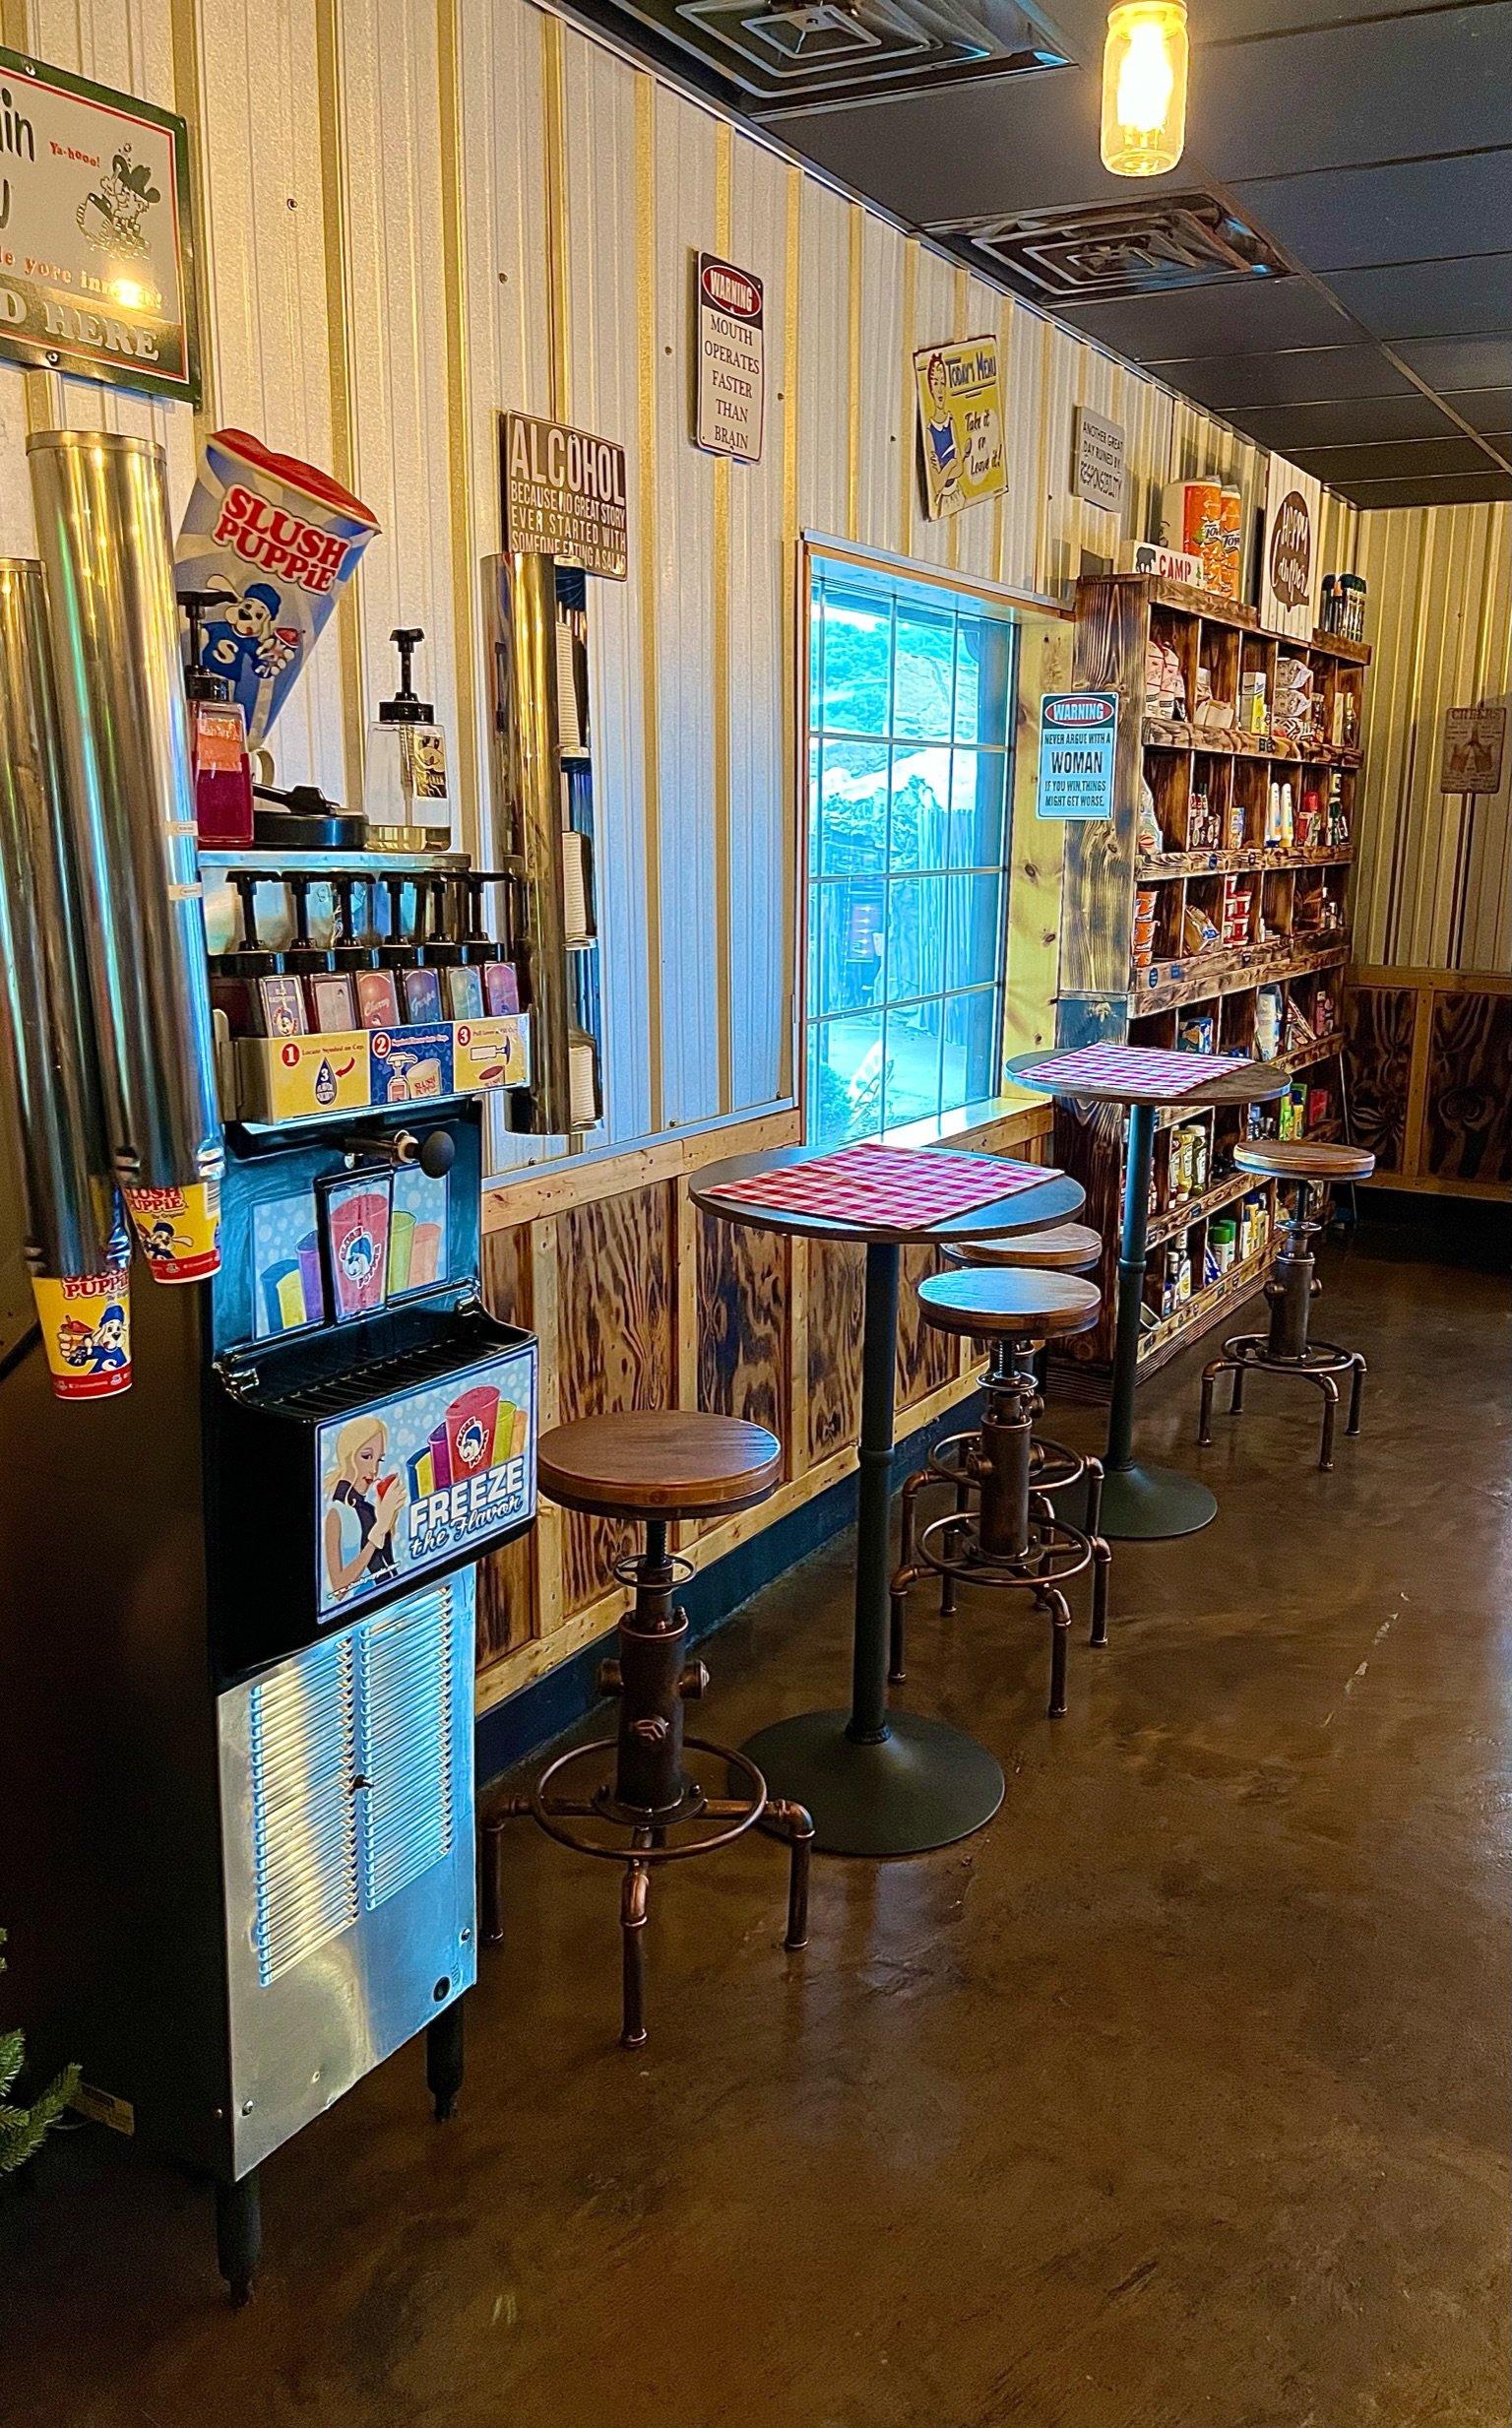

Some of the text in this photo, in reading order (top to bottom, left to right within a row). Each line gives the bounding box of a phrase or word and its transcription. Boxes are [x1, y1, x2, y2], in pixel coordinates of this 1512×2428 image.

[25, 257, 72, 284] yore
[710, 270, 753, 311] WARNING
[43, 301, 159, 361] HERE
[711, 314, 753, 346] MOUTH
[705, 340, 760, 375] OPERATES
[712, 370, 753, 398] FASTER
[716, 399, 748, 423] THAN
[965, 410, 990, 432] Take it
[715, 425, 748, 450] BRAIN
[511, 418, 625, 506] ALCOHOL
[971, 444, 1002, 476] Leave it!
[511, 480, 625, 530] BECAUSE NO GREAT STORY
[225, 487, 349, 570] SLUSH
[511, 506, 626, 552] EVER STARTED WITH
[512, 531, 560, 553] SOMEONE
[595, 550, 600, 567] A
[602, 550, 626, 575] SALAD
[1160, 554, 1192, 582] CAMP
[213, 638, 239, 666] S
[1053, 702, 1103, 721] WARNING
[1044, 733, 1110, 744] NEVER ARGUE WITH A
[1051, 751, 1102, 773] WOMAN
[1045, 781, 1051, 792] IF
[1052, 781, 1065, 792] YOU
[1082, 780, 1105, 792] THINGS
[1045, 796, 1065, 806] MIGHT
[1067, 796, 1079, 806] GET
[376, 1037, 387, 1054] 2
[460, 1028, 470, 1044] 3
[286, 1046, 296, 1063] 1
[320, 1067, 330, 1081] 3
[410, 1457, 524, 1538] FREEZE
[410, 1494, 522, 1557] the Flavor
